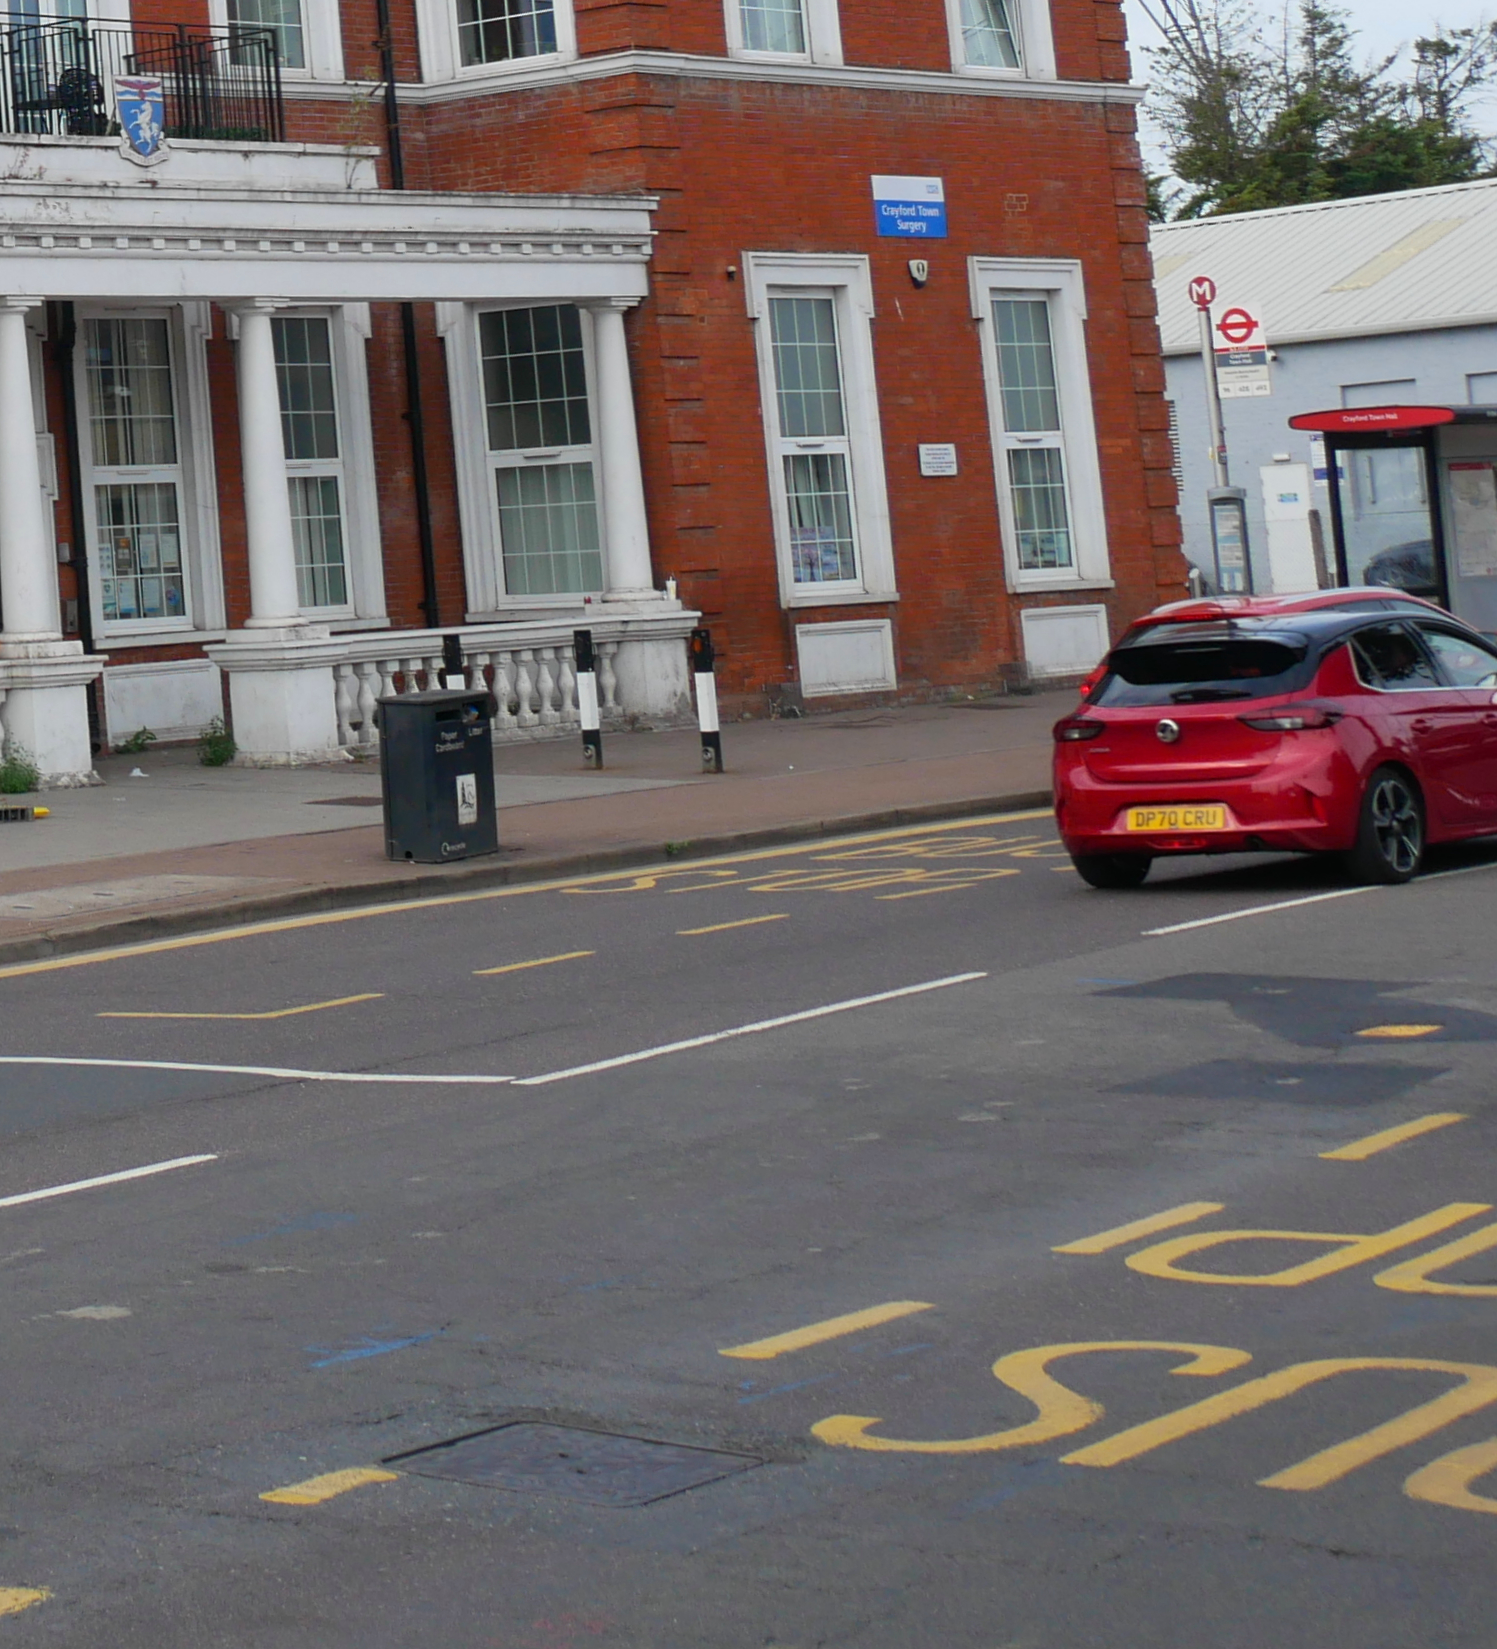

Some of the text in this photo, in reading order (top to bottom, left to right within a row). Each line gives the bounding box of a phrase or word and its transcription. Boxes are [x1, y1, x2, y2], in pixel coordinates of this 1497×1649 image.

[882, 204, 940, 218] Crayford Town
[897, 219, 927, 233] Surgery
[1192, 281, 1211, 302] M
[440, 727, 483, 741] Paper Litter
[435, 740, 464, 753] Cardboard
[1136, 810, 1216, 827] DP70 CRU
[811, 1339, 1497, 1515] US
